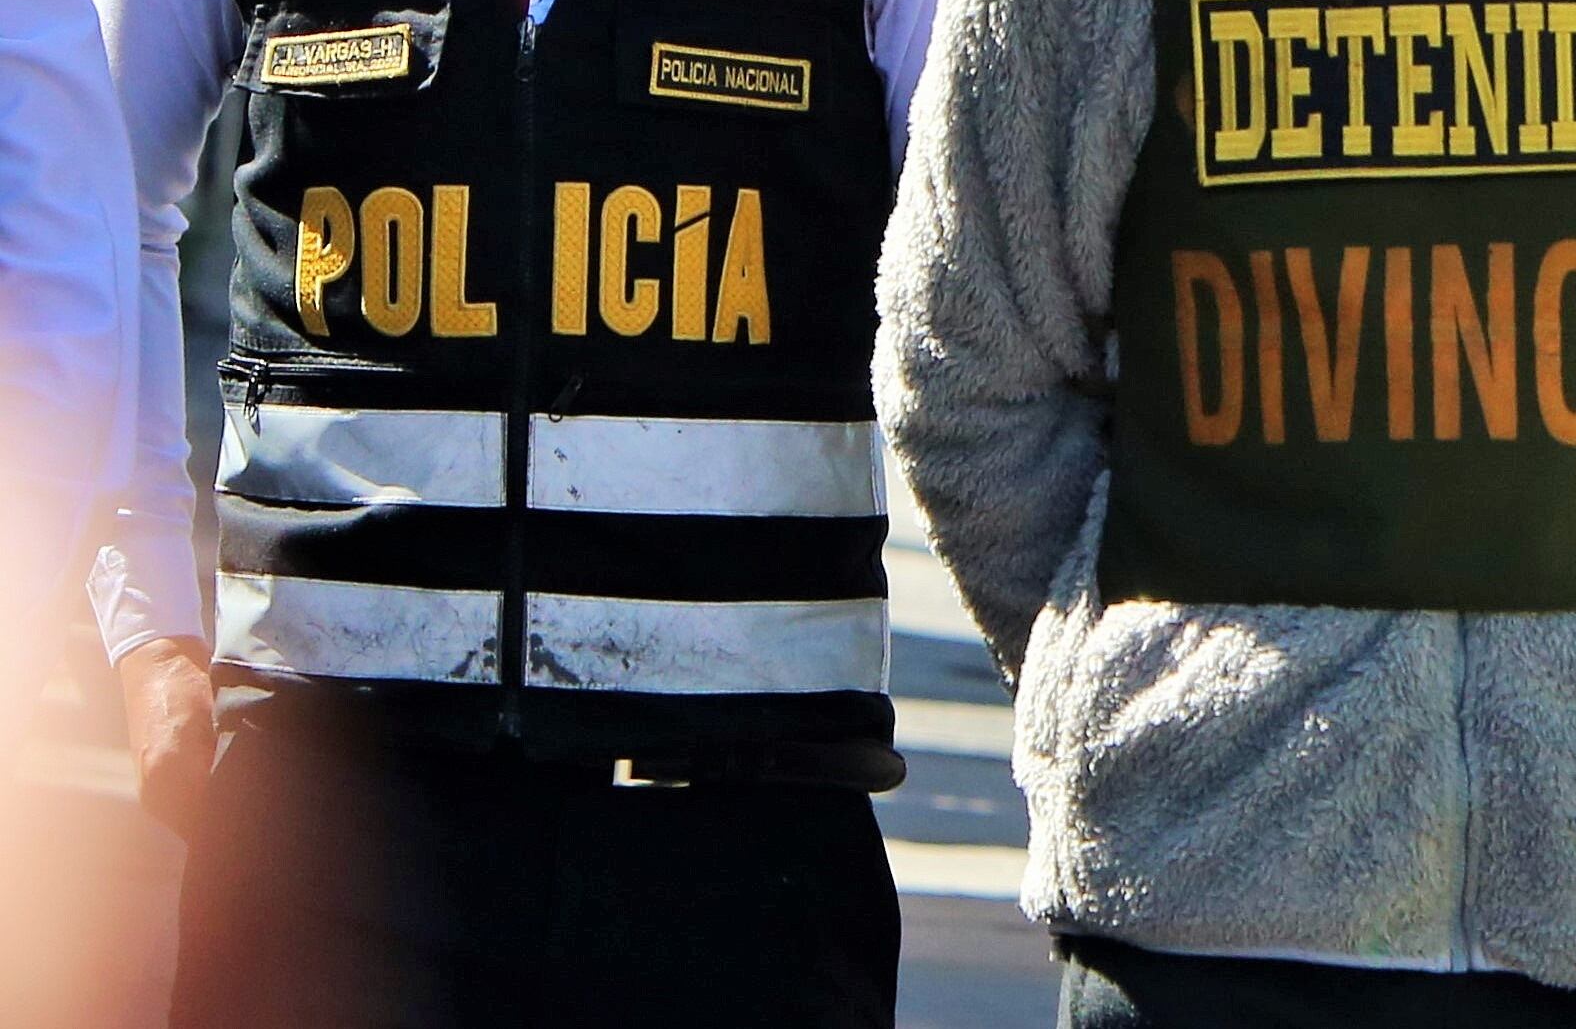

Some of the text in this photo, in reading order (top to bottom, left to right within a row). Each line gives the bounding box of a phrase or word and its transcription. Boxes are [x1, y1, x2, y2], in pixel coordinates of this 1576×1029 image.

[304, 40, 372, 65] VARGAS
[660, 57, 800, 96] POLICIA NACIONAL
